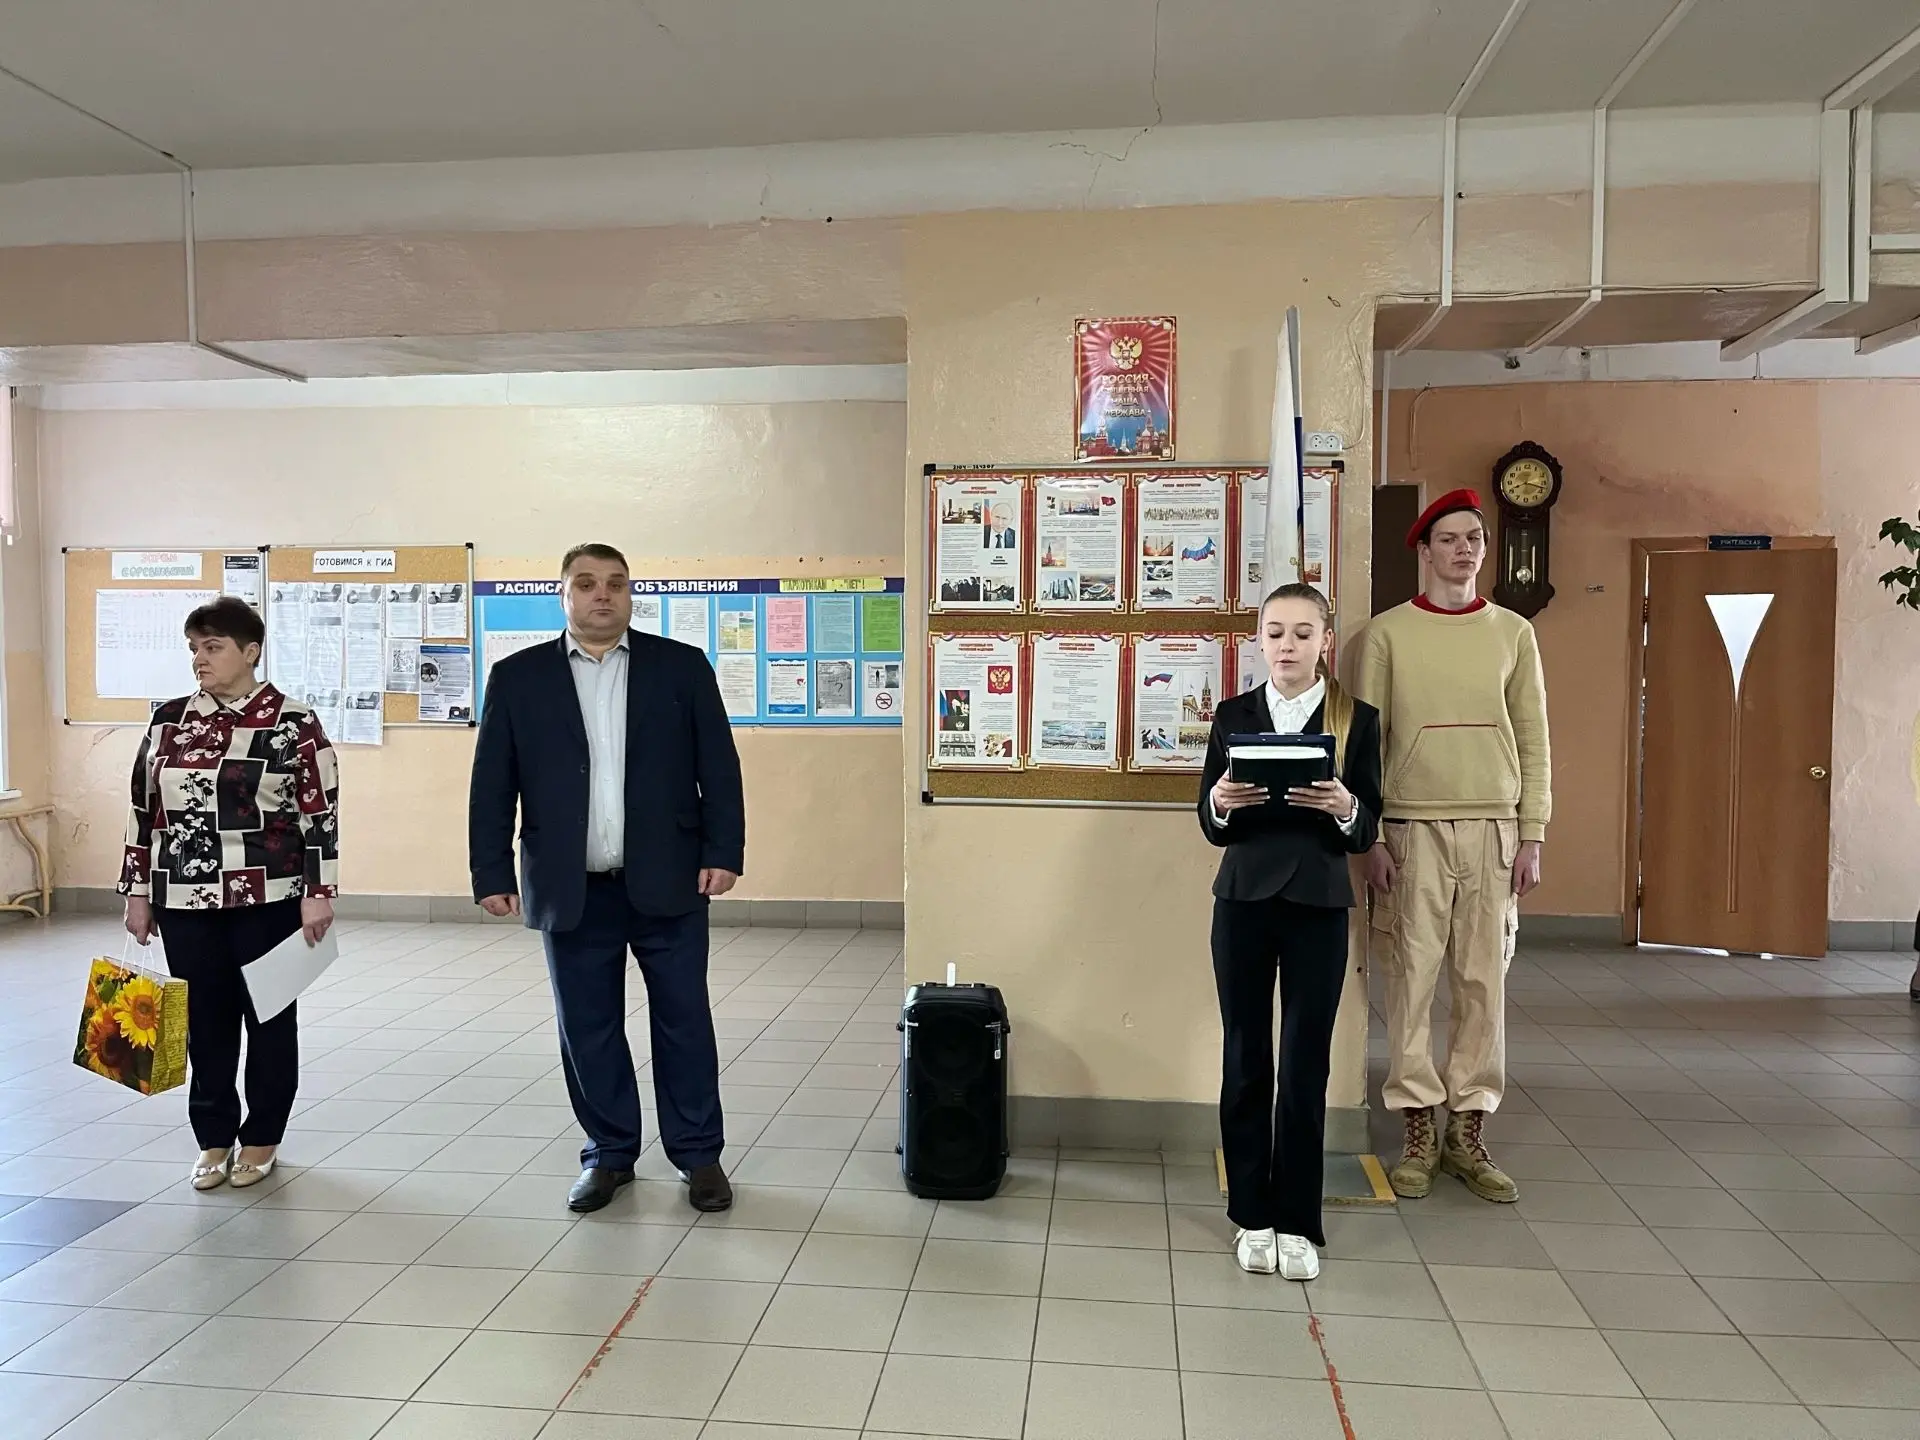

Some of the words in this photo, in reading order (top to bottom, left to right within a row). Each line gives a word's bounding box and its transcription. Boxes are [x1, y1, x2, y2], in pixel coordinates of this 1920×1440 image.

[315, 557, 363, 566] ГОТОВИМСЯ
[375, 558, 393, 567] ГИА
[634, 580, 739, 592] ОБЪЯВЛЕНИЯ
